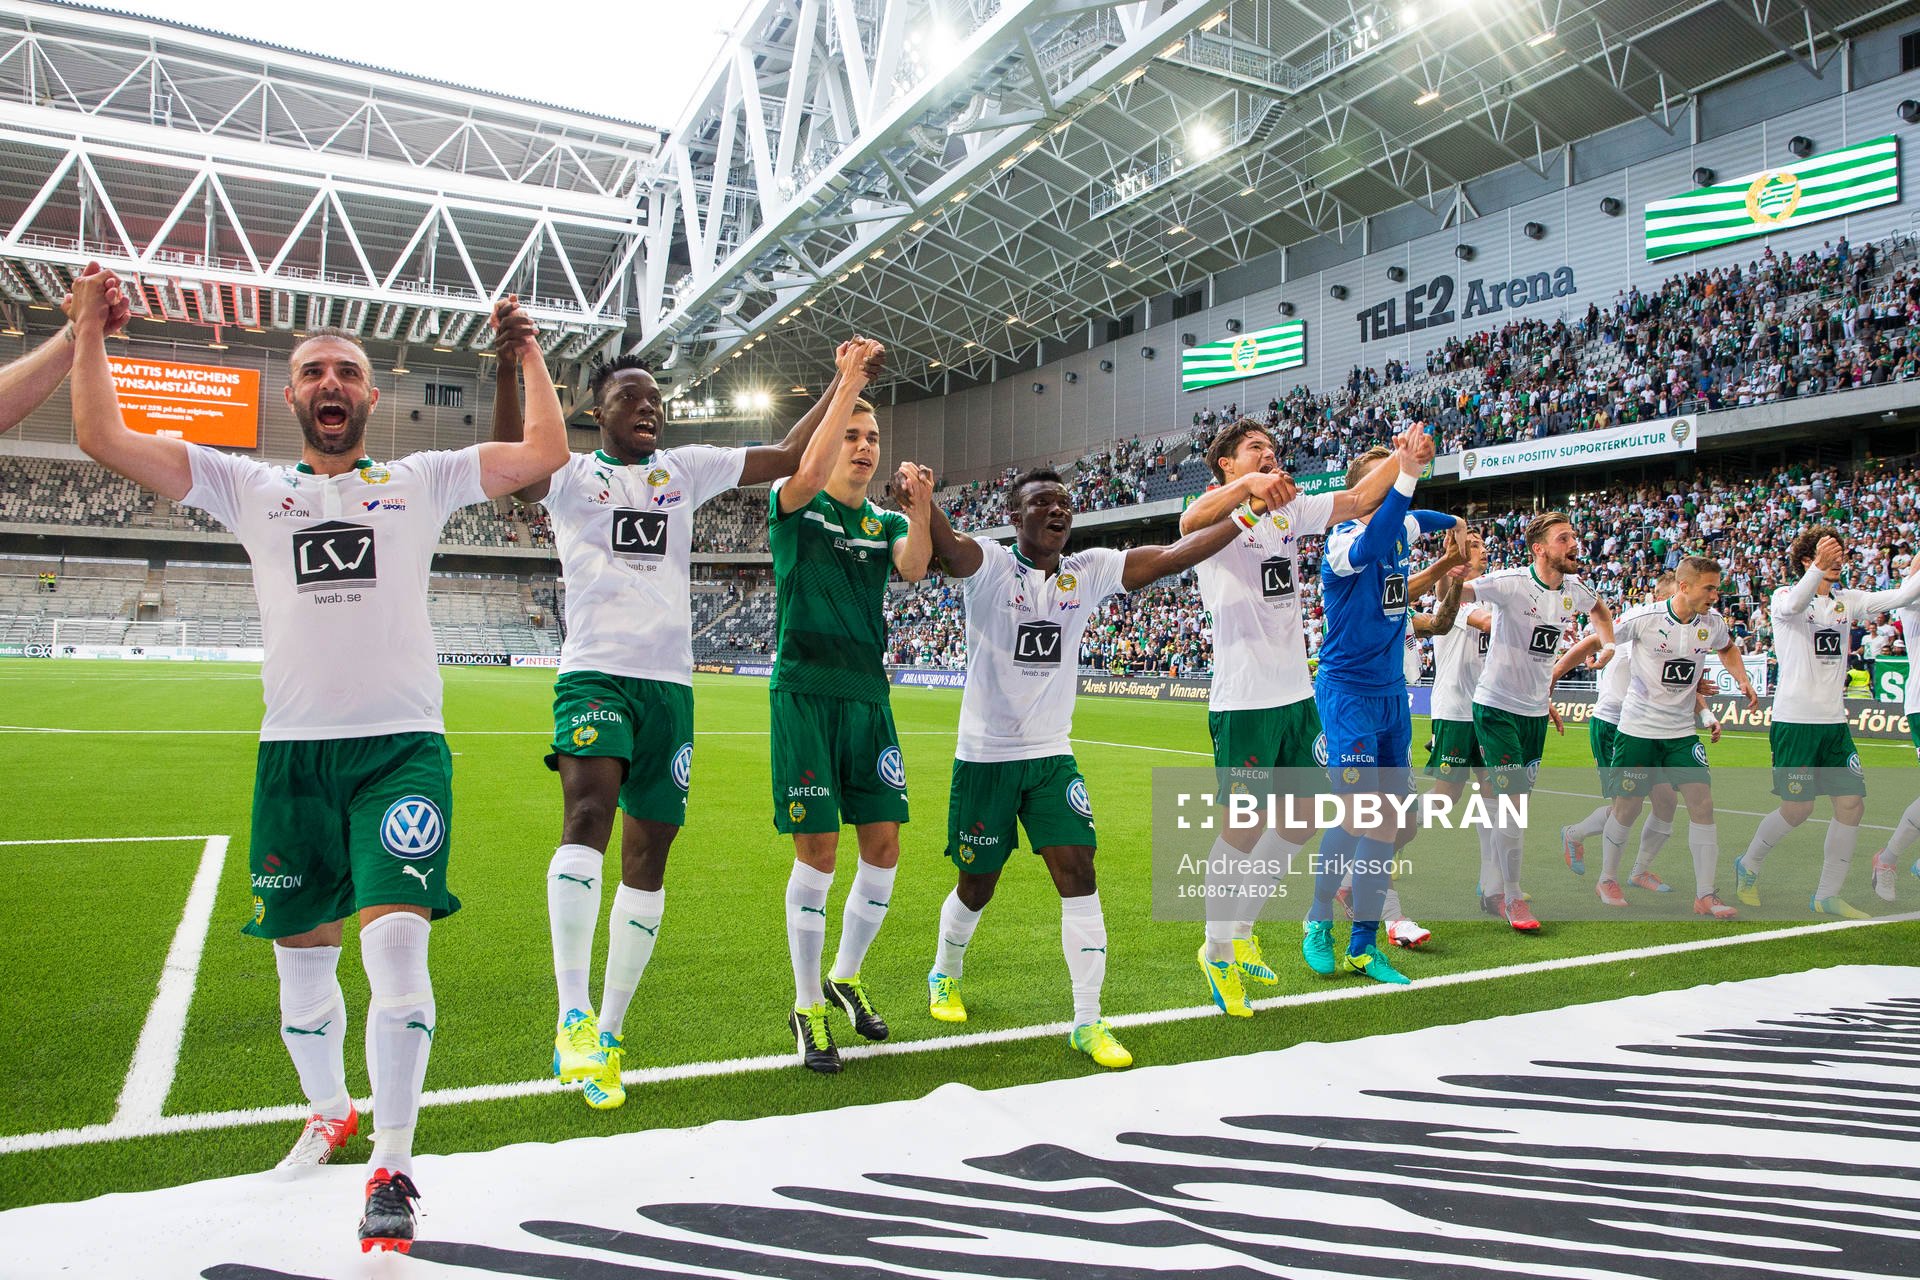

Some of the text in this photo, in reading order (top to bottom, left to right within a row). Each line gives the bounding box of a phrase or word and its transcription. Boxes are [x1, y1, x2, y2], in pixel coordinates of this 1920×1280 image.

[1357, 266, 1577, 343] TELE2 Arena
[165, 368, 240, 384] MATCHENS
[112, 377, 232, 397] SYNSAMSTJÄRNA!
[1481, 433, 1666, 468] FÖR EN POSITIV SUPPORTERKULTUR
[268, 509, 310, 520] SAFECON
[616, 517, 666, 547] LW
[299, 536, 372, 575] LW
[1264, 564, 1292, 591] LW
[314, 592, 362, 604] lwab.se
[1384, 582, 1405, 604] LW
[1018, 631, 1060, 656] LW
[1532, 631, 1559, 650] LW
[1663, 664, 1695, 681] LW
[571, 710, 623, 726] SAFECON
[1341, 753, 1375, 763] SAFECON
[1230, 767, 1269, 780] SAFECON
[788, 786, 830, 797] SAFECON
[959, 831, 999, 846] SAFECON
[251, 873, 302, 889] SAFECON
